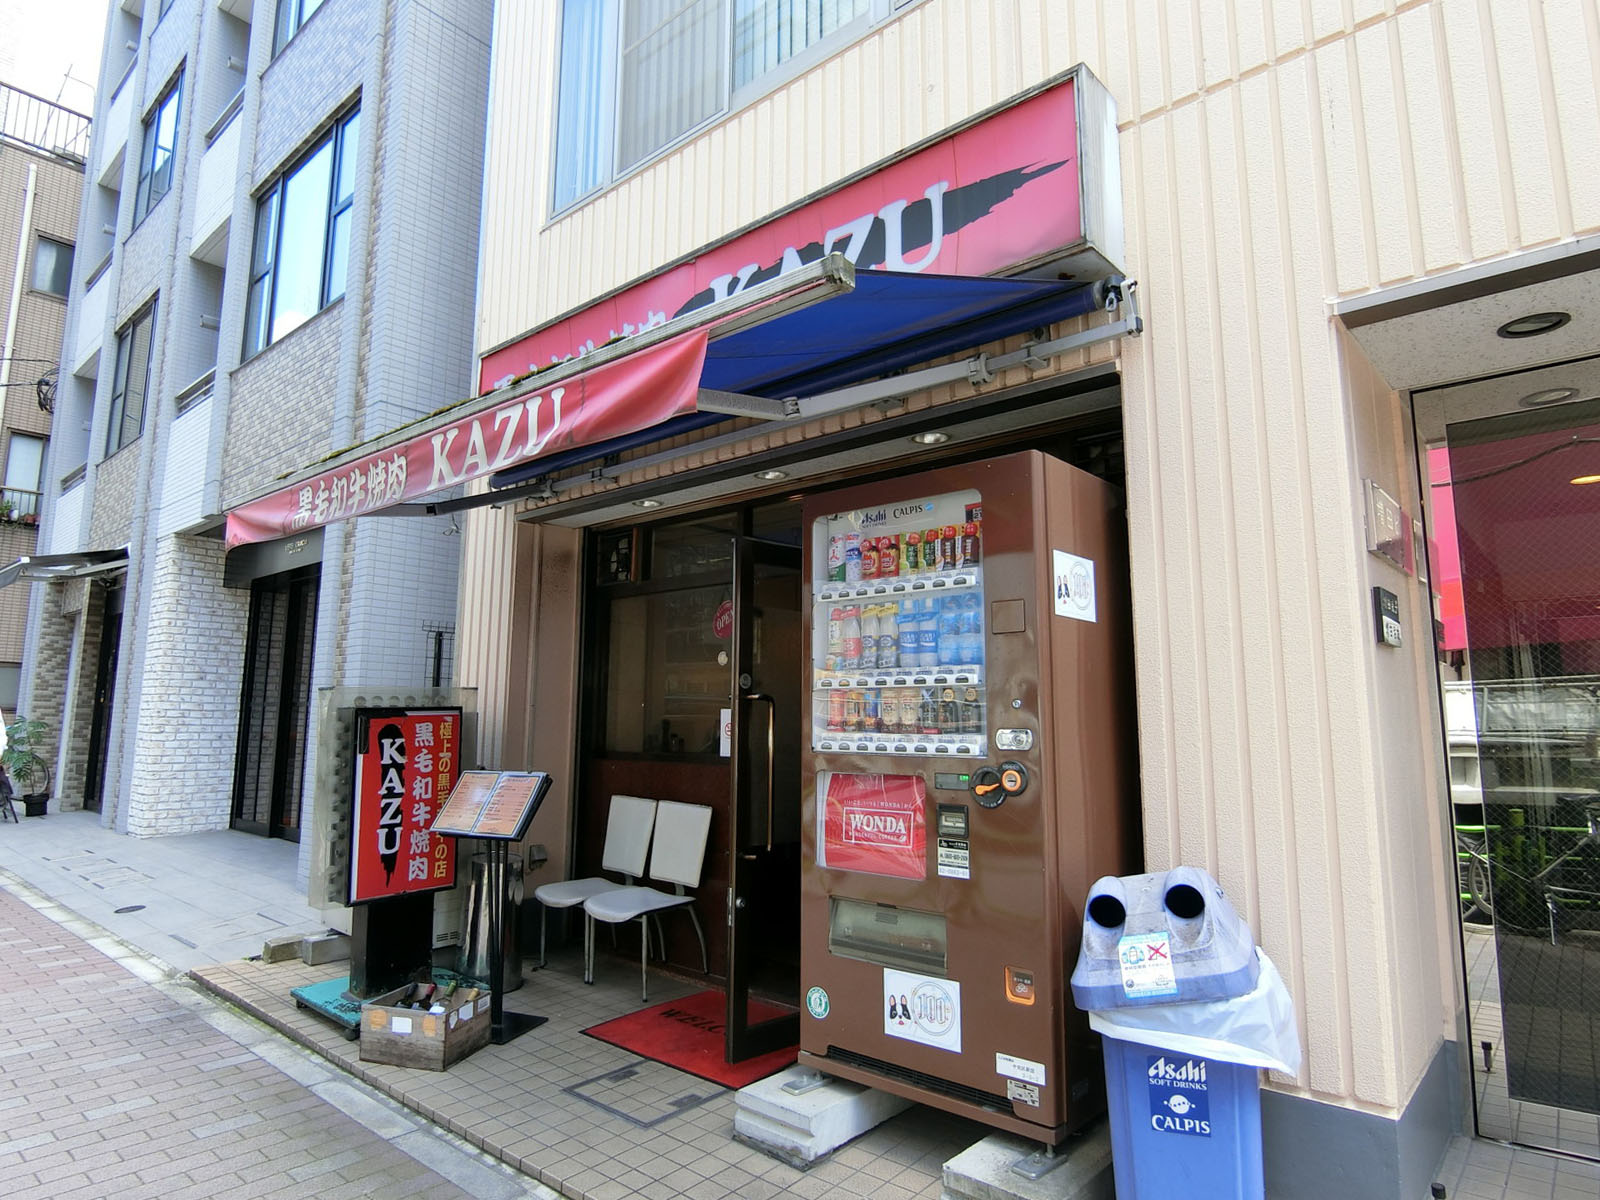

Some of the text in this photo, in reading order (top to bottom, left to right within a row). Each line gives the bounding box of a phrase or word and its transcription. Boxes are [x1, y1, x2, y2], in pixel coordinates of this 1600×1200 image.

[291, 388, 566, 529] 黒毛和牛焼肉 KAZU
[861, 504, 923, 524] Asahi CALPIS
[376, 738, 407, 855] KAZU
[408, 721, 434, 882] 黒毛和牛焼肉
[433, 721, 454, 879] 極上の黒毛の店
[849, 813, 907, 834] WONDA
[1147, 1056, 1208, 1082] Asahi
[1148, 1078, 1208, 1091] SOFT DRINKS
[1151, 1114, 1211, 1135] CALPIS
